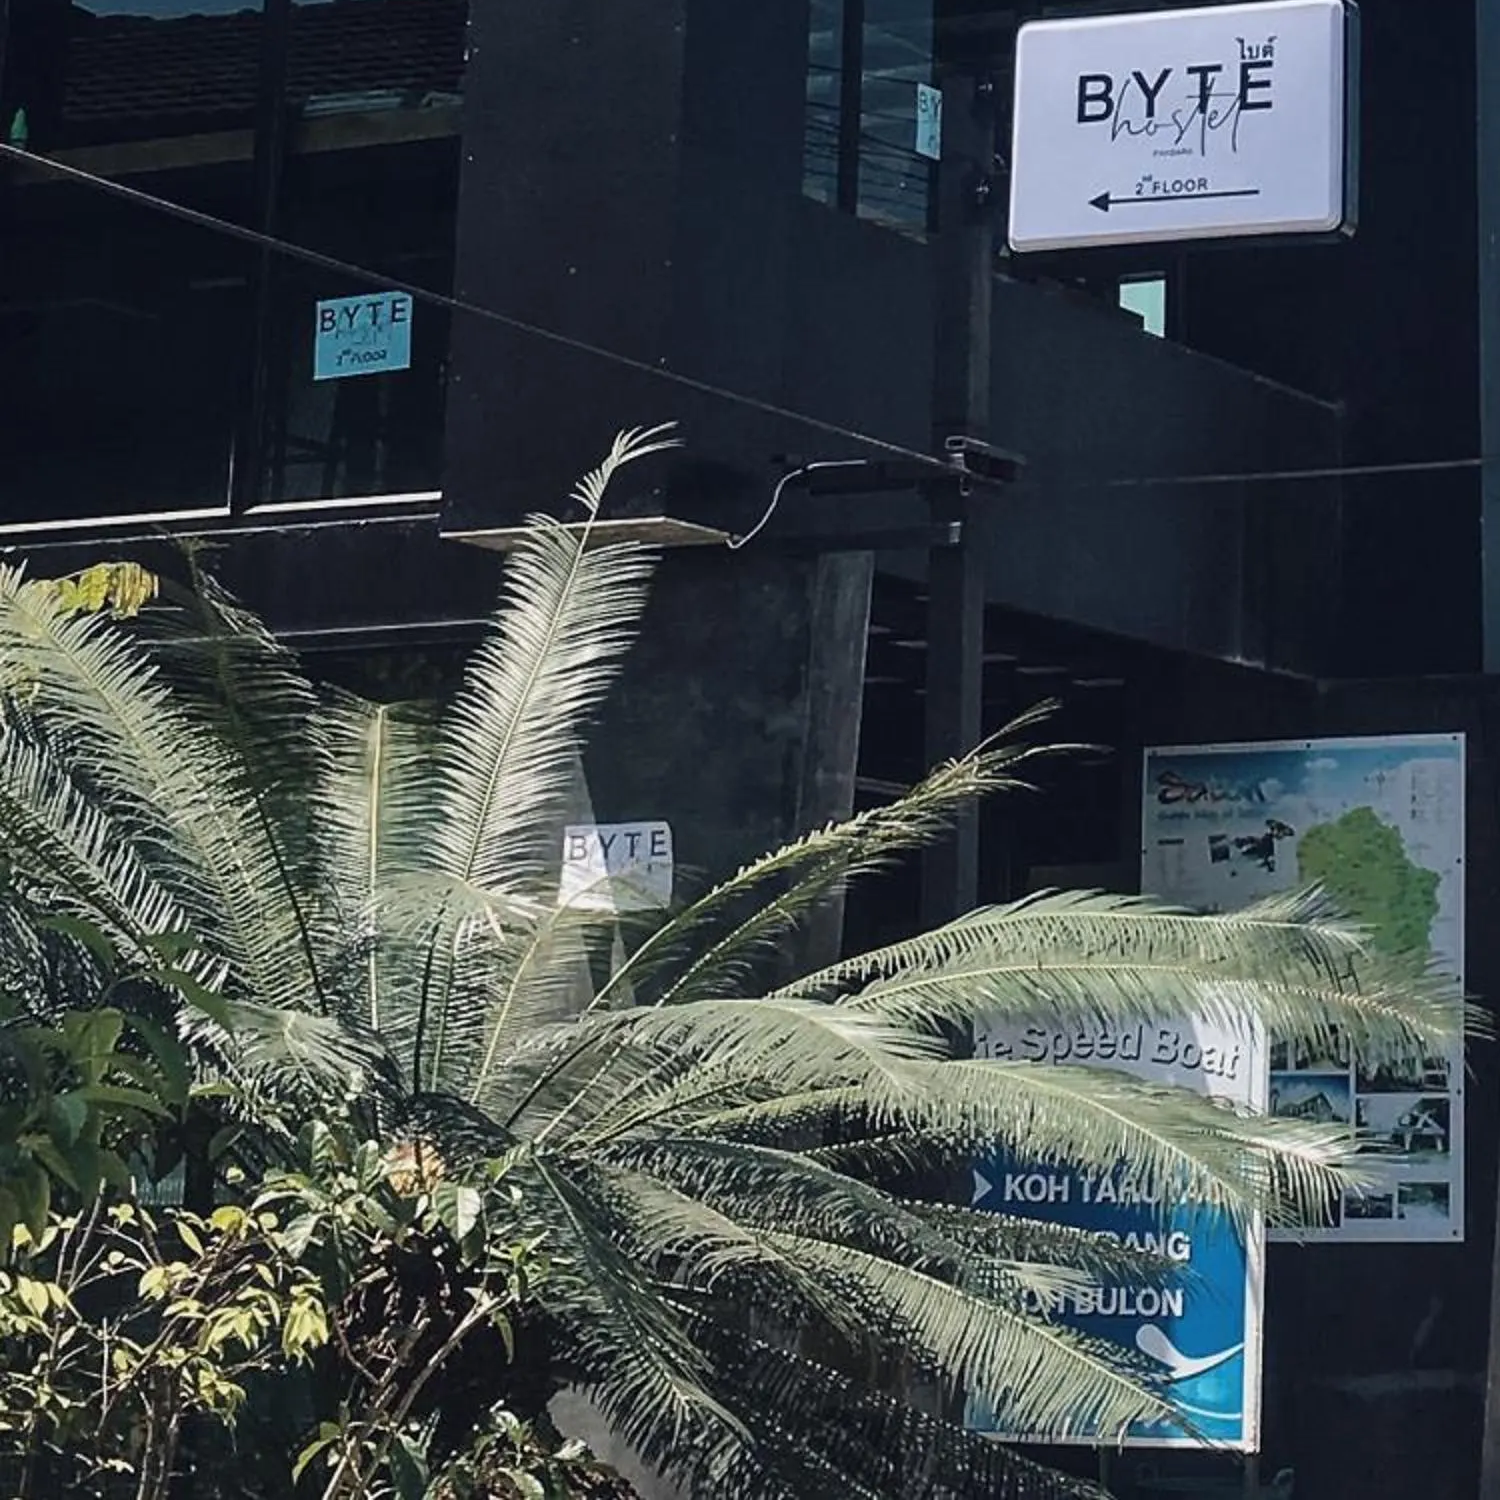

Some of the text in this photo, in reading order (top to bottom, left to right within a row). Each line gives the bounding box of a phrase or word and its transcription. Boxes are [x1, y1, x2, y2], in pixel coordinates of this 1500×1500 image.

[1236, 37, 1277, 59] ไบต์
[1077, 60, 1273, 123] BYTE
[1152, 177, 1209, 195] FLOOR
[320, 297, 410, 332] BYTE
[569, 830, 667, 860] BYTE
[1019, 1024, 1143, 1065] Speed
[1151, 1028, 1241, 1079] Boat
[1003, 1172, 1070, 1203] KOH
[1074, 1286, 1183, 1317] BULON
